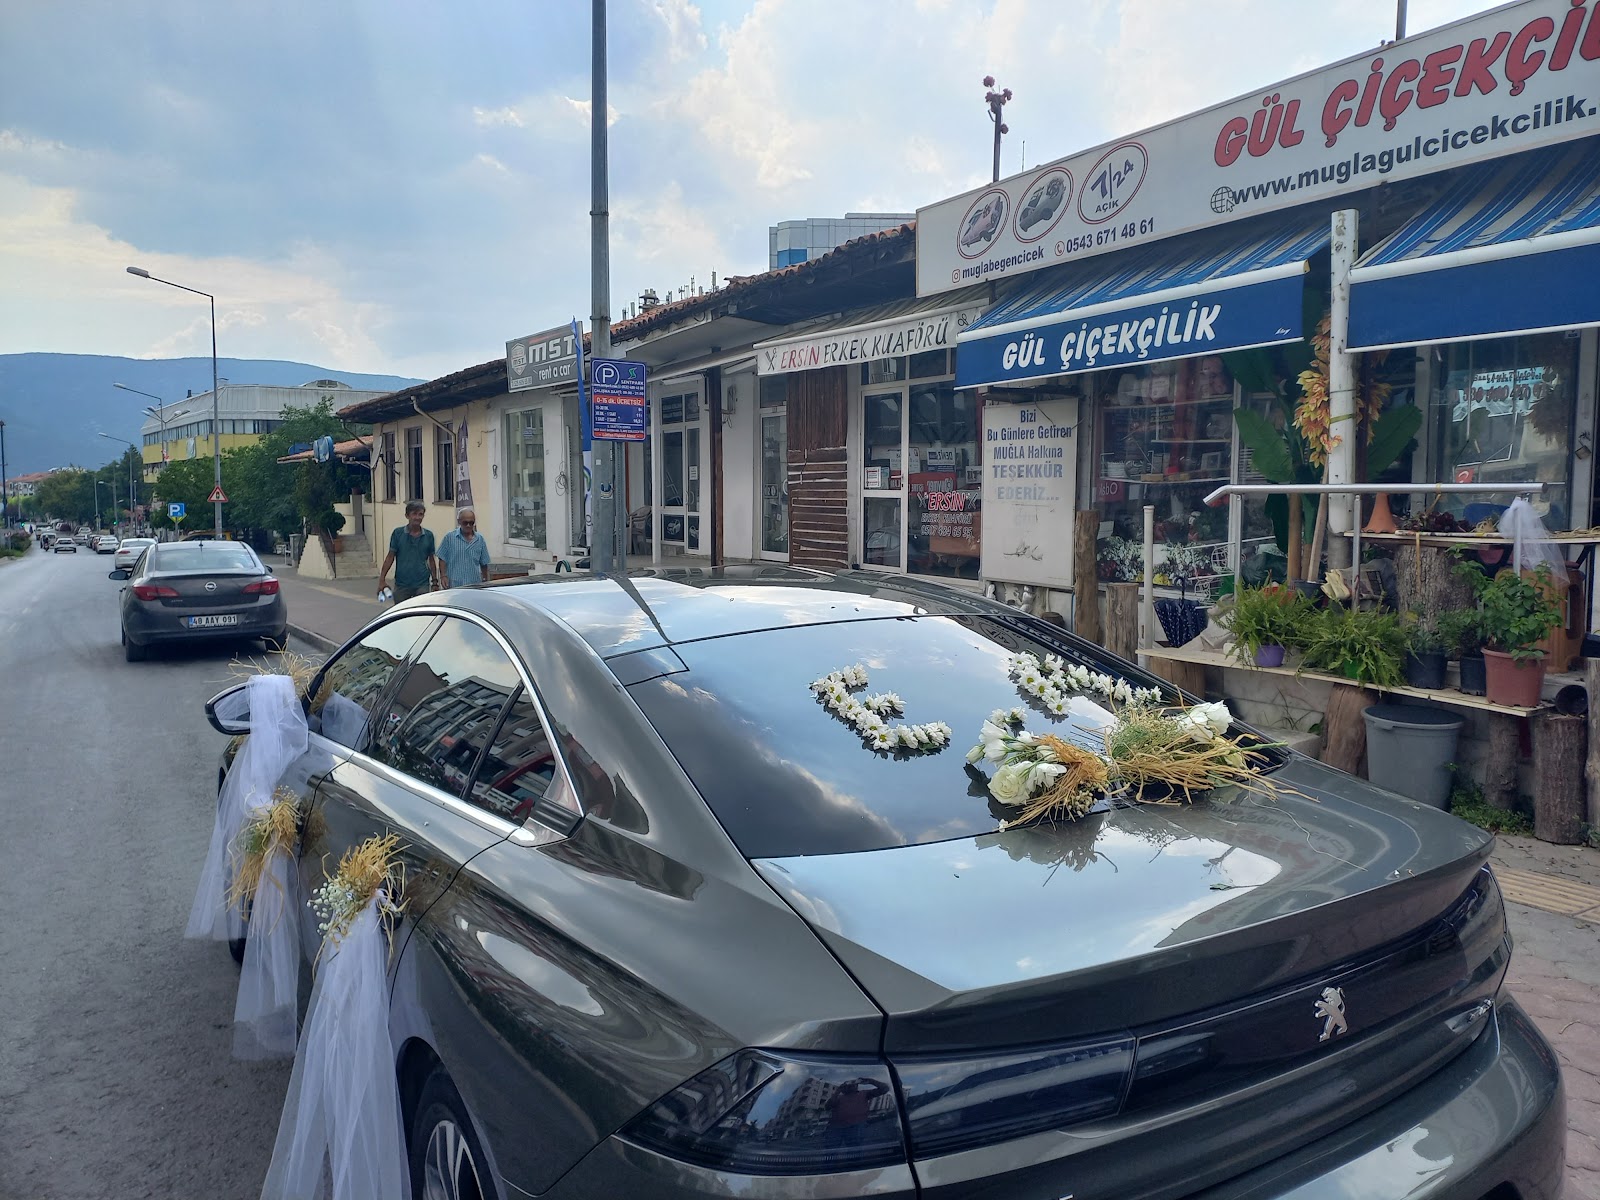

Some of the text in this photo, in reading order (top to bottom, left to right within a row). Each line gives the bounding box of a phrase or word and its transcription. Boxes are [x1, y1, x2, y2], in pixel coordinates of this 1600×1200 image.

[1214, 93, 1304, 167] GÜL
[1091, 159, 1134, 200] 7/24
[1095, 199, 1119, 213] AÇIK
[1066, 216, 1154, 254] 0543 671 48 61
[962, 245, 1044, 279] muglabegencicek
[780, 317, 949, 370] ERSİN ERKEK KUAFÖRÜ
[1002, 300, 1222, 370] GÜL ÇİÇEKÇİLİK
[528, 334, 576, 364] MST
[538, 363, 572, 381] rent a car
[1020, 410, 1036, 423] Bizi
[987, 425, 1072, 442] Bu Günlere Getiren
[993, 443, 1063, 460] MUĞLA Halkına
[992, 461, 1063, 481] TEŞEKKÜR
[928, 490, 966, 512] ERSİN
